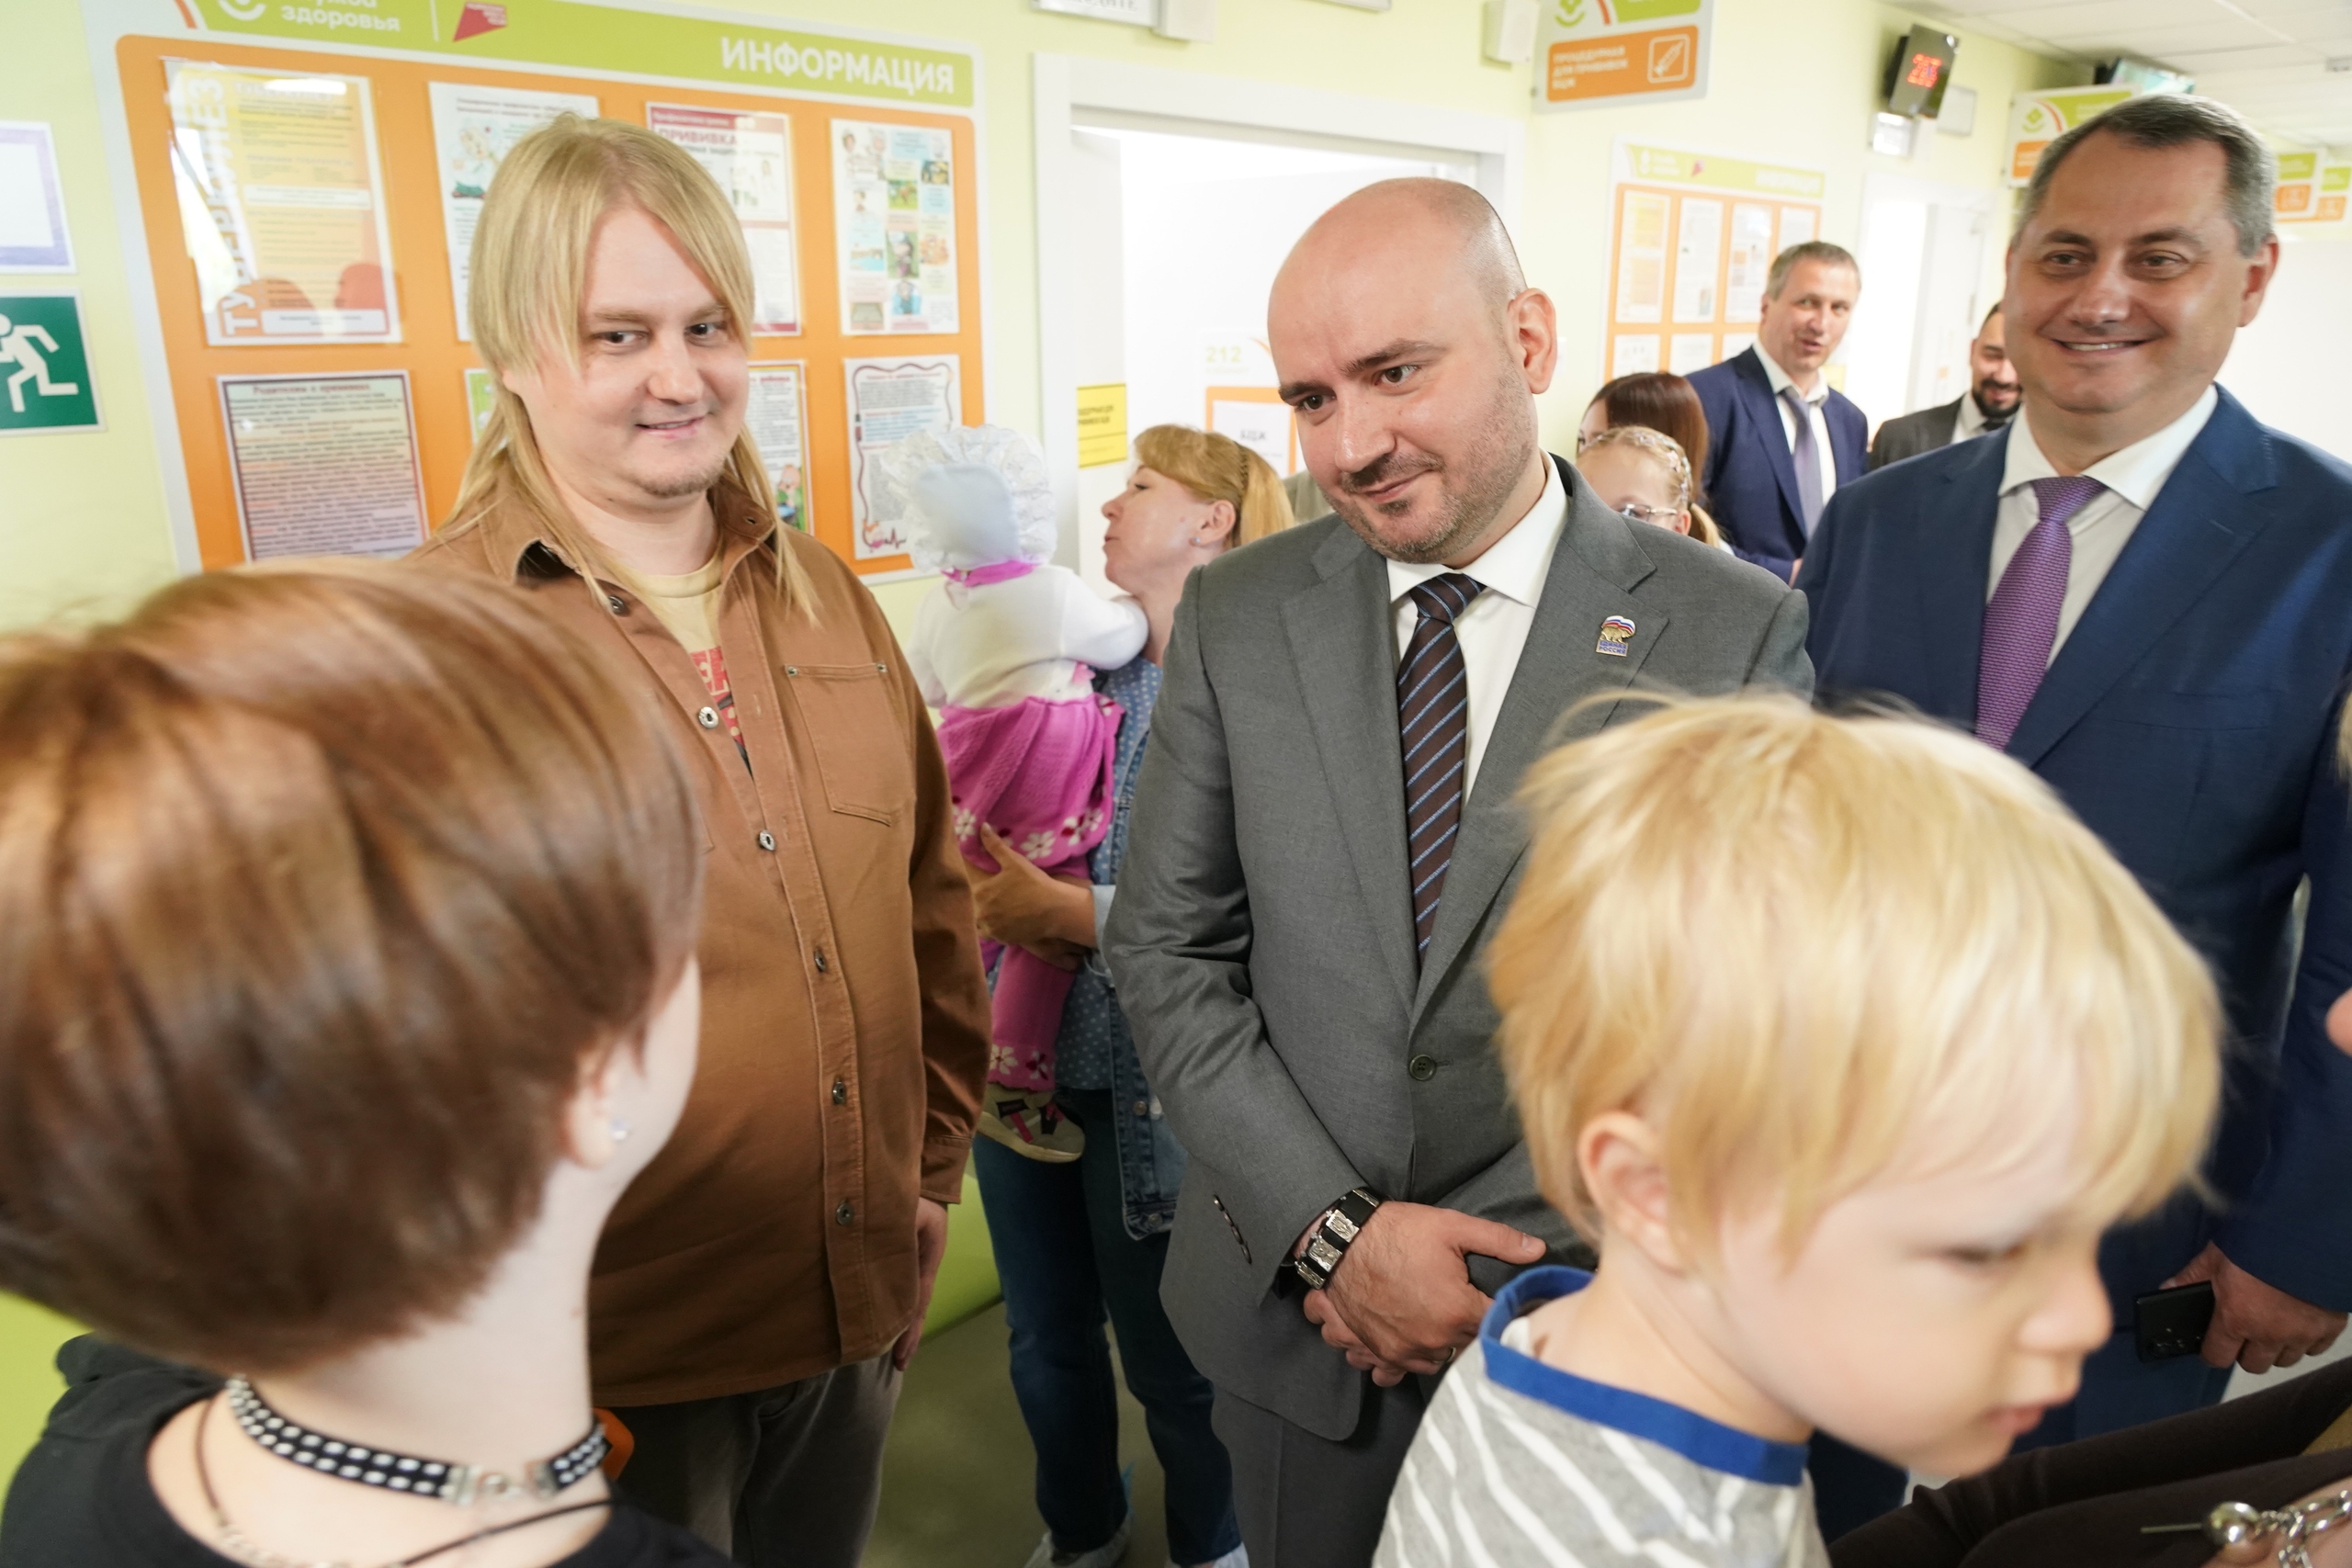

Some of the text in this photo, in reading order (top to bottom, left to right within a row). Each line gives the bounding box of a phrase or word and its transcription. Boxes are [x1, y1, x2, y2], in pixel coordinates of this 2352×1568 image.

[280, 5, 401, 31] здоровья
[721, 37, 953, 95] ИНФОРМАЦИЯ
[1205, 346, 1242, 363] 212
